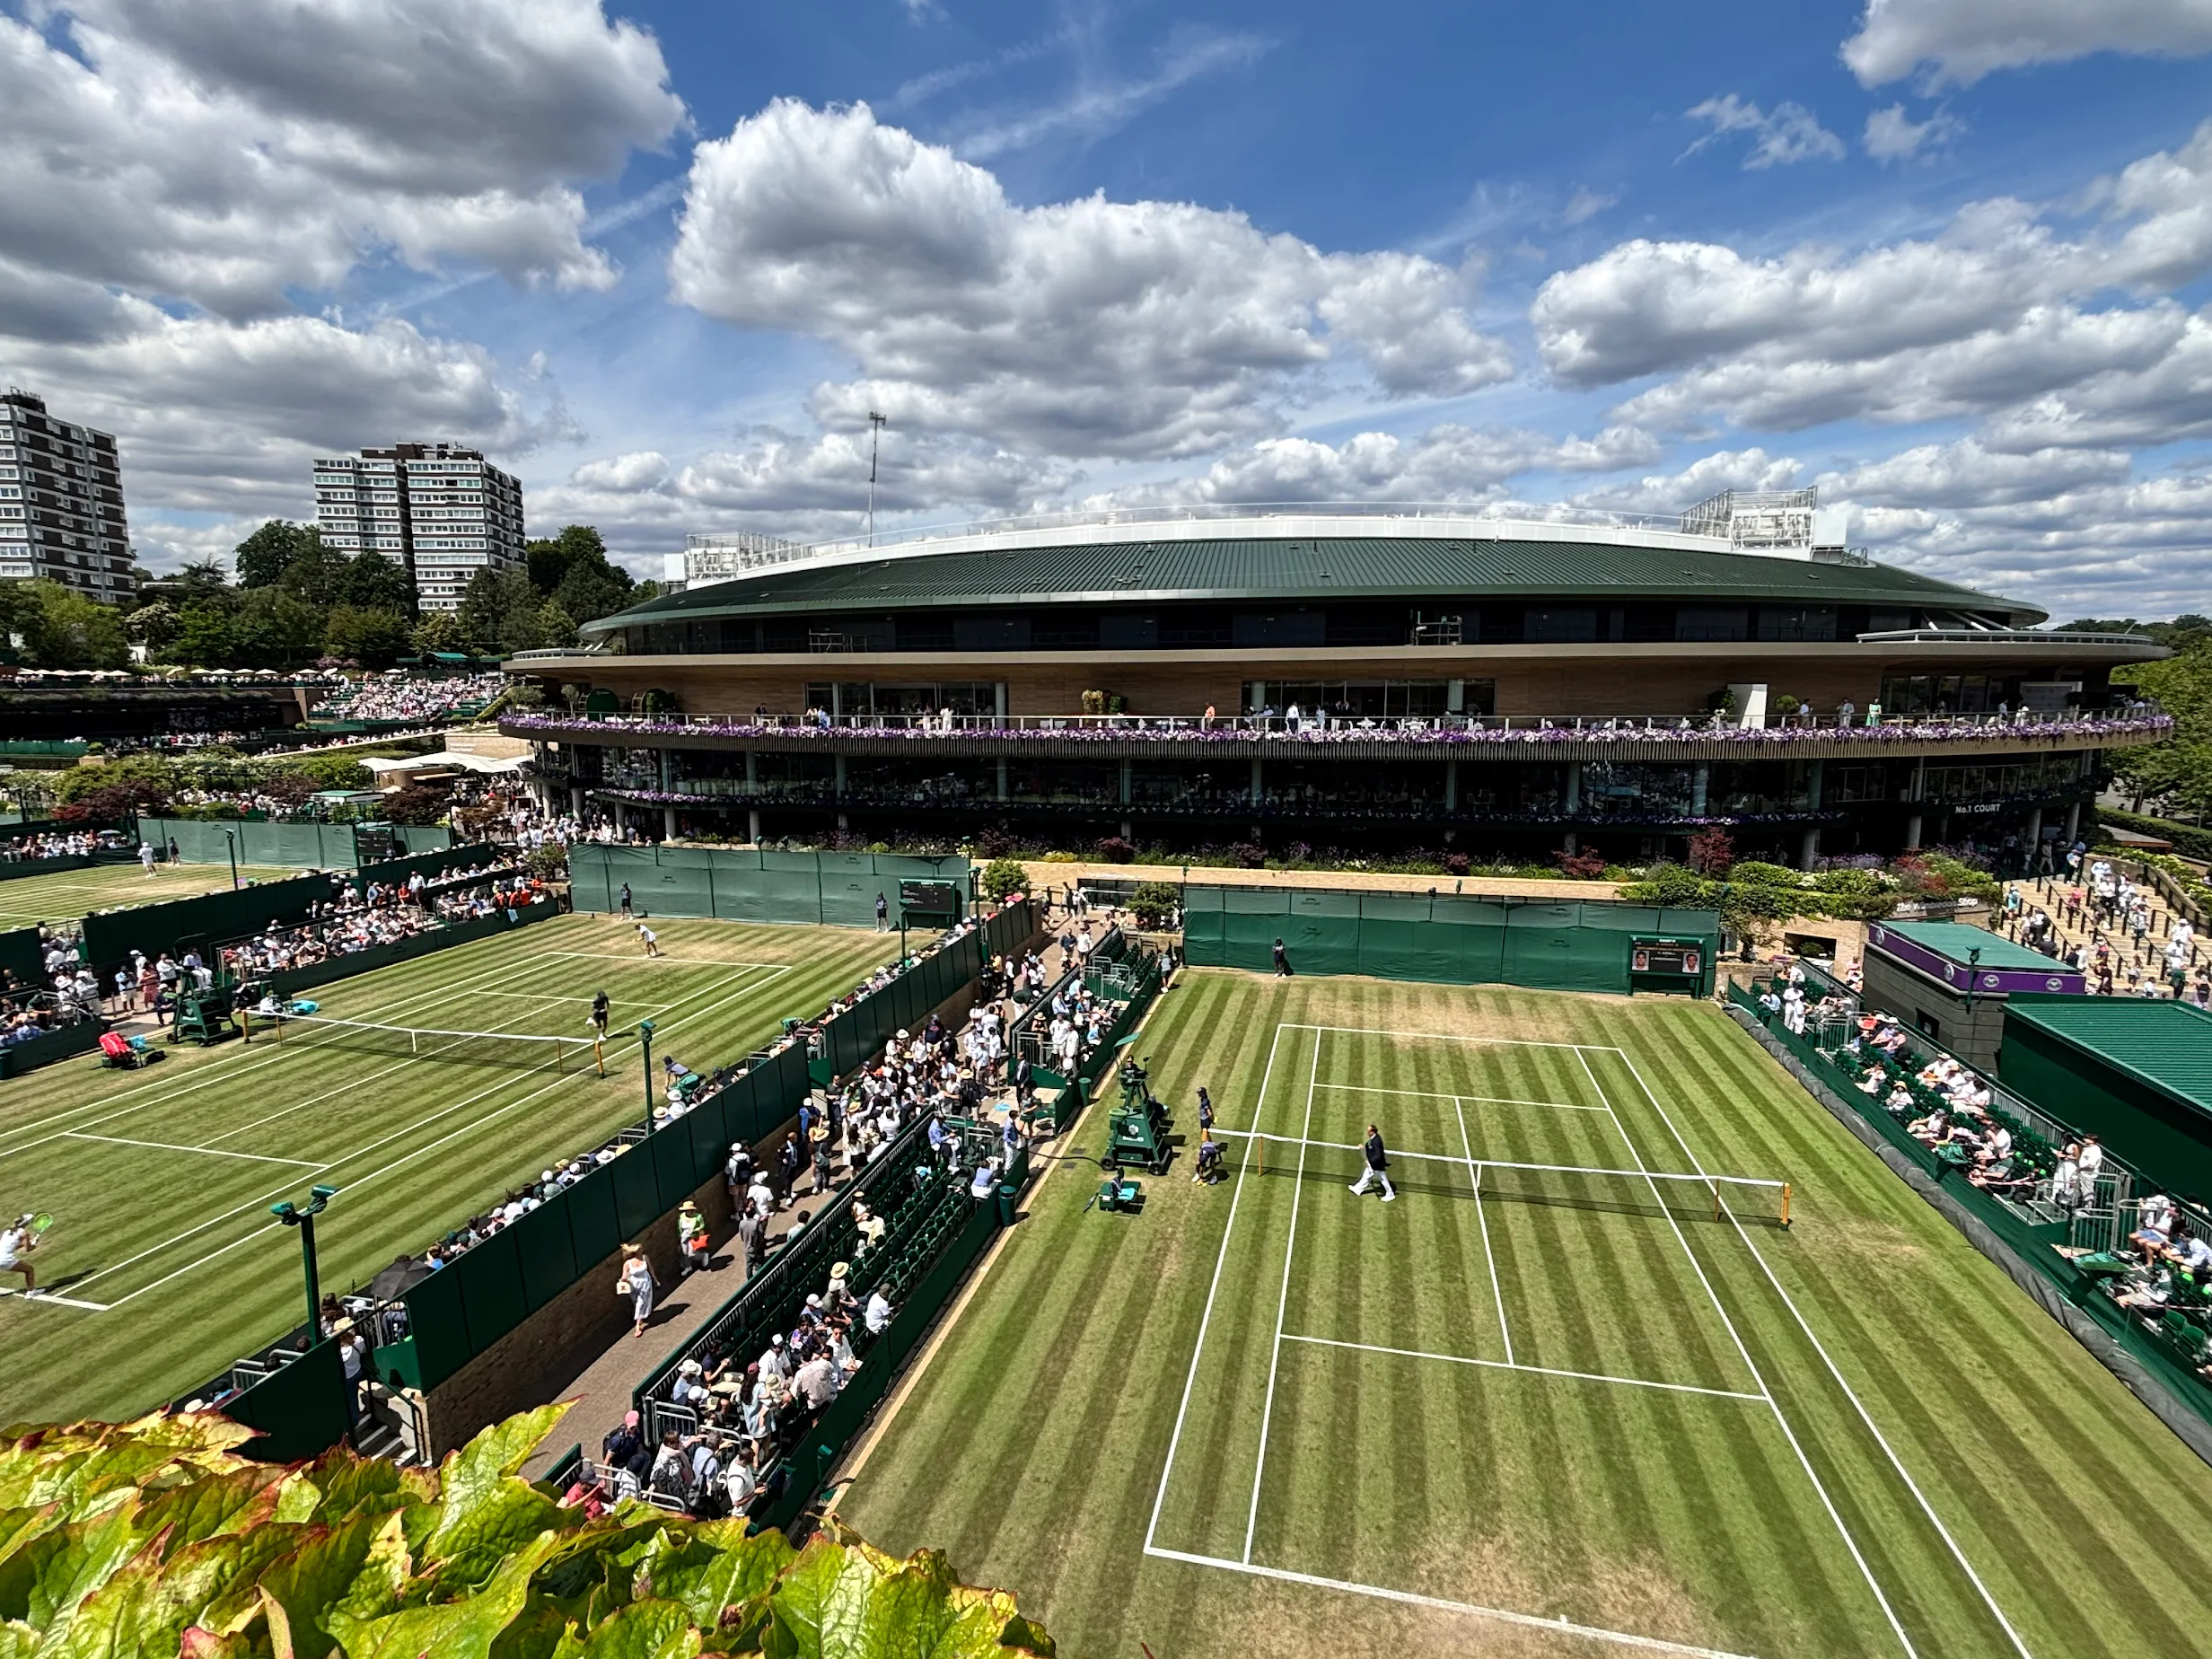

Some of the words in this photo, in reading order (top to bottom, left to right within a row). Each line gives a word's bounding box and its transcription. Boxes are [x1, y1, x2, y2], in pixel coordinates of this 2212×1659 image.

[1955, 804, 1971, 813] No.1
[1974, 803, 2001, 812] COURT
[1897, 902, 1912, 912] The
[1913, 900, 1957, 910] Wimbledon
[1957, 897, 1979, 907] Shop
